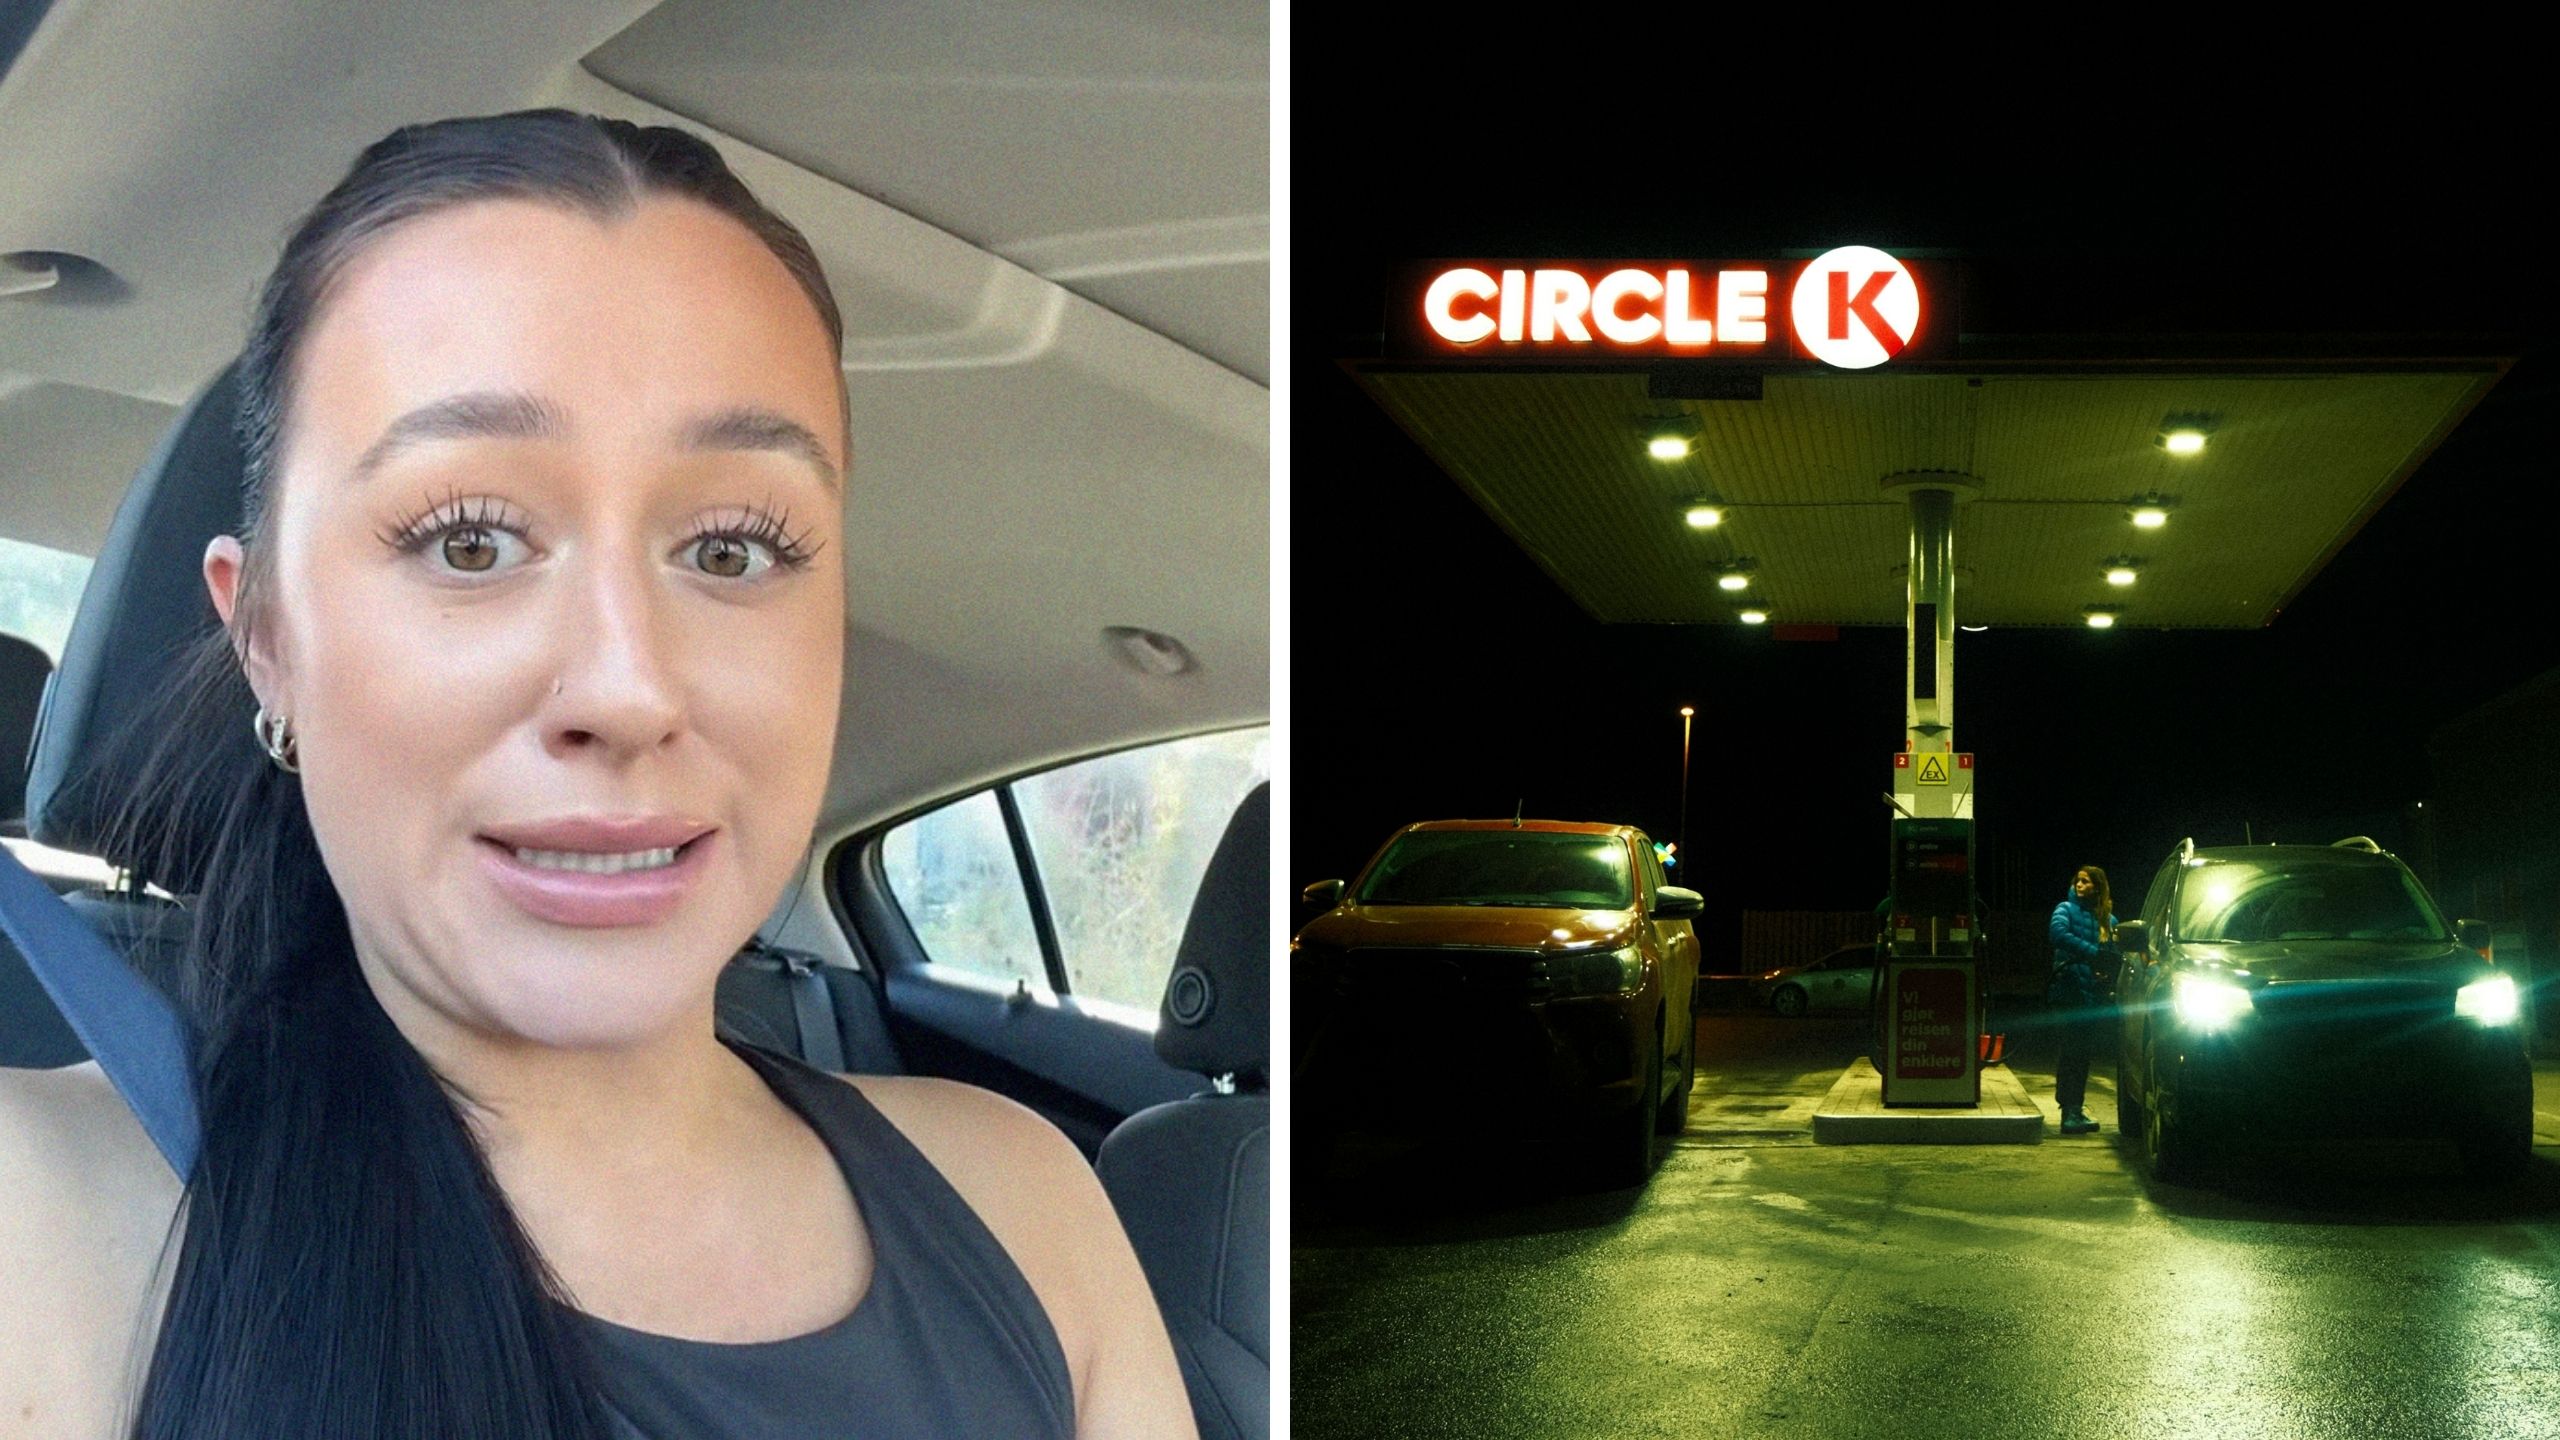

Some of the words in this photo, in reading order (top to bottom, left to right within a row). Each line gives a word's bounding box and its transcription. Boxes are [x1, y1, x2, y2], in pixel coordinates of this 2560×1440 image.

[1424, 267, 1768, 344] CIRCLE
[1827, 270, 1905, 360] K
[1926, 770, 1940, 779] EX
[1902, 1023, 1951, 1037] reisen
[1902, 1038, 1927, 1052] din
[1902, 1054, 1961, 1068] enklere
